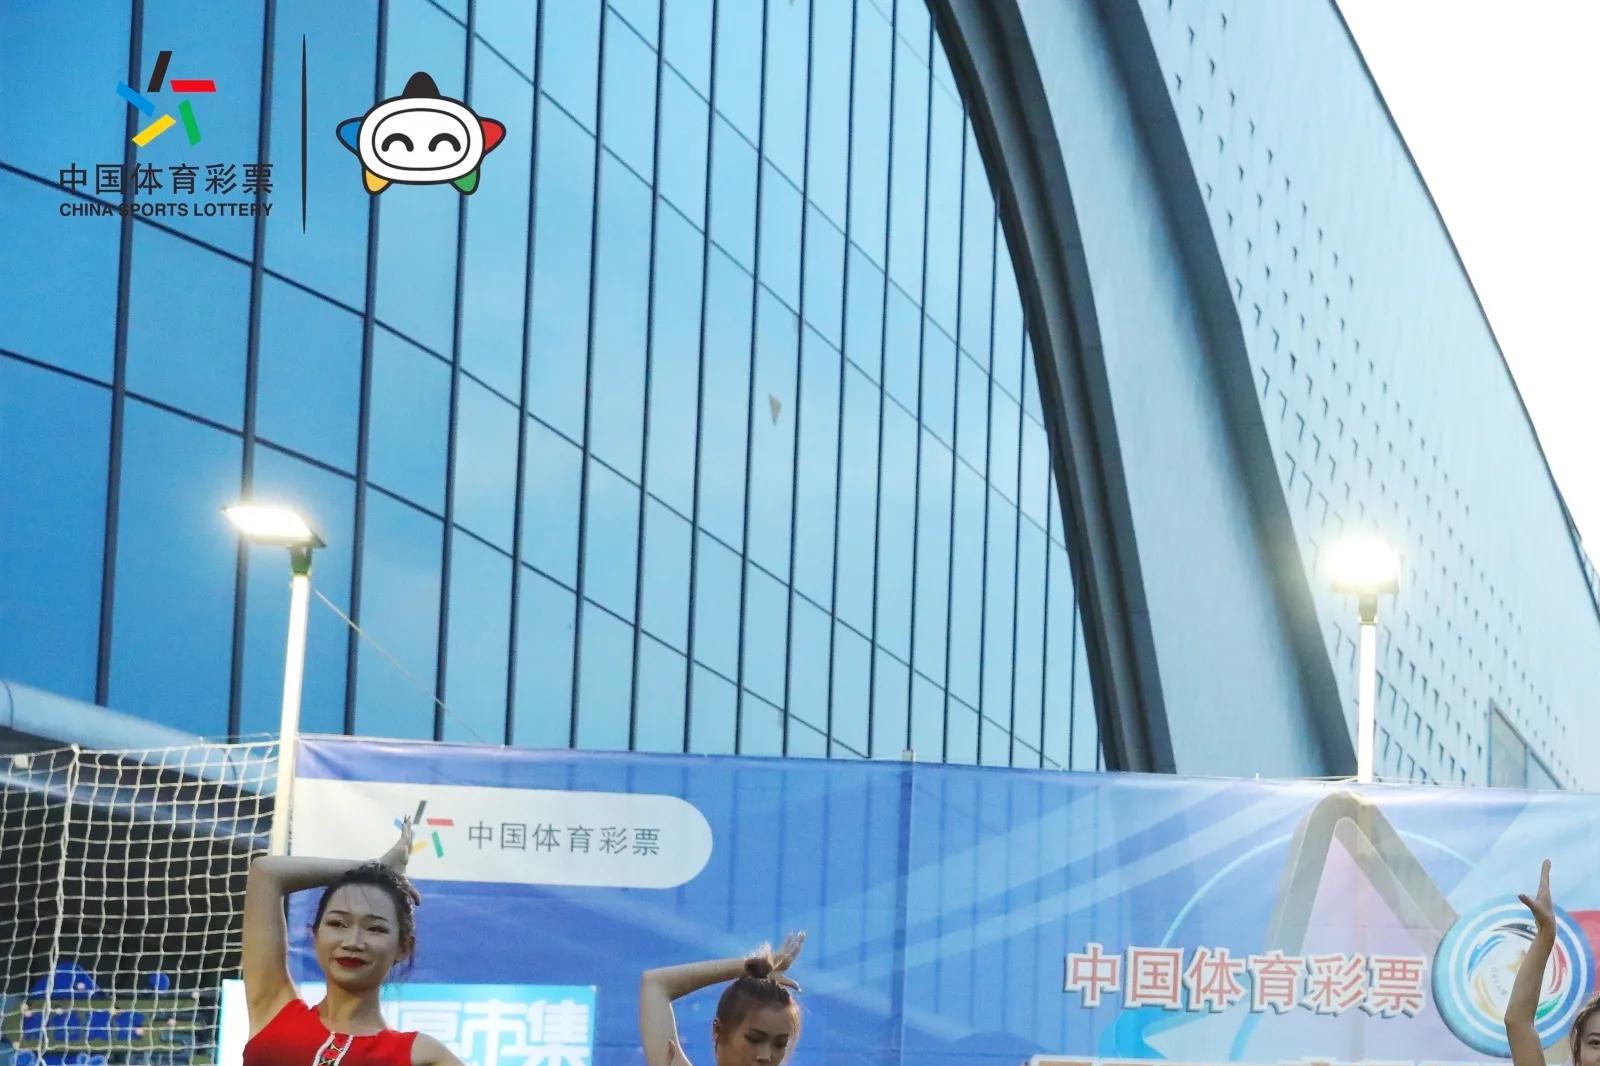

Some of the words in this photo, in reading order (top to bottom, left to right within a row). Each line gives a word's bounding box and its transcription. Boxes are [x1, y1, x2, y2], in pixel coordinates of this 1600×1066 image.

[467, 820, 662, 857] 中国体育彩票
[1067, 943, 1426, 1014] 中国体育彩票
